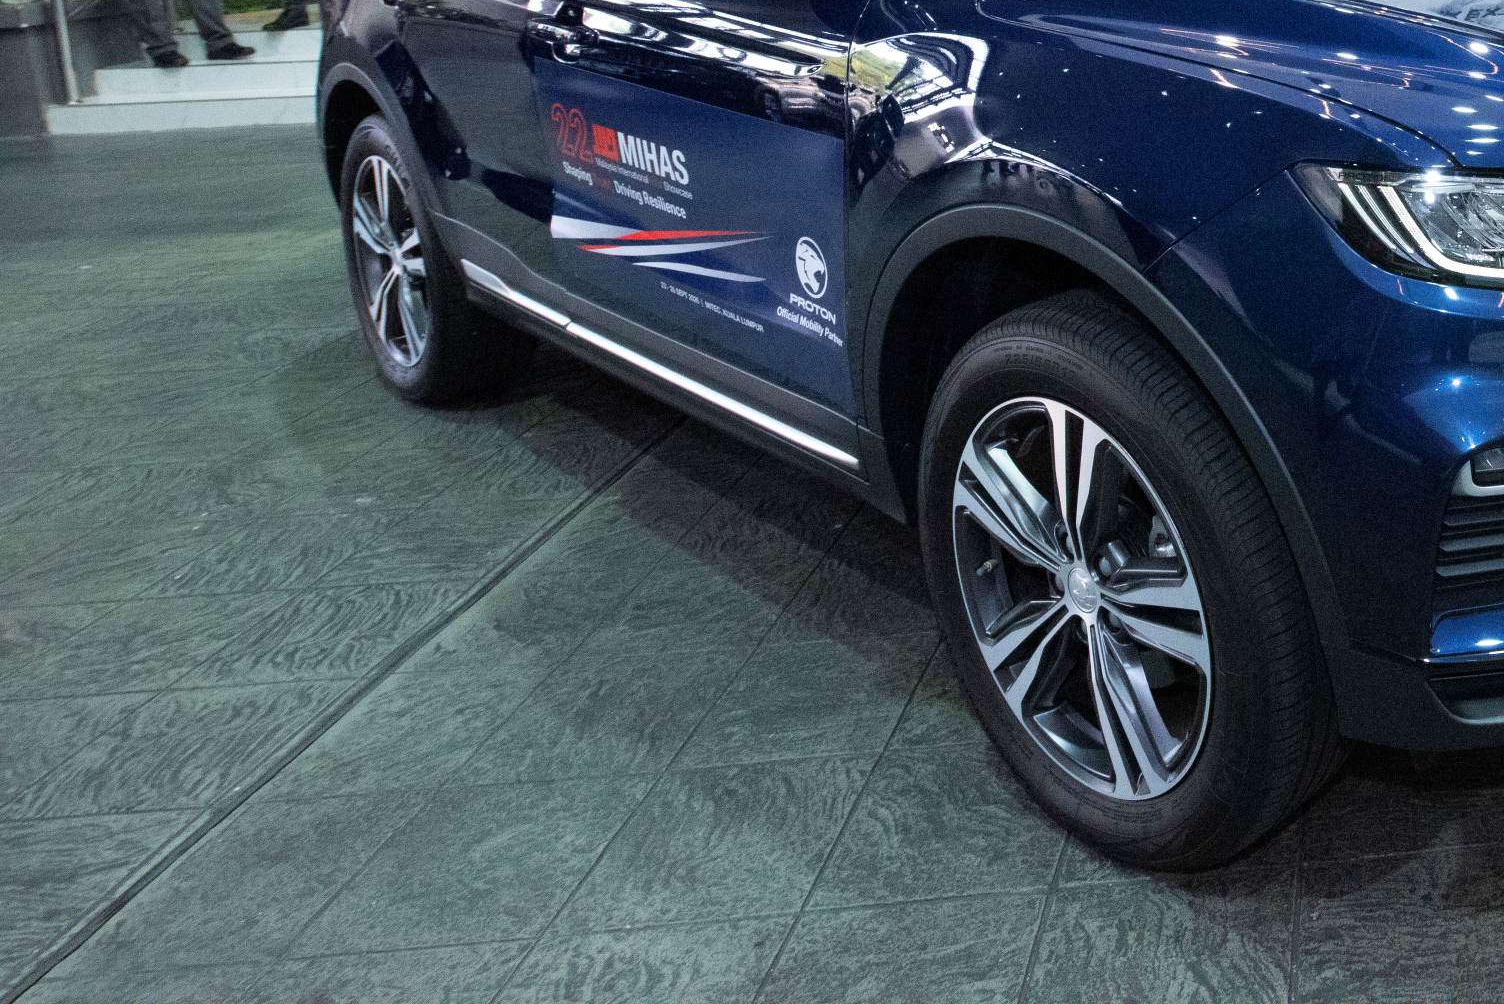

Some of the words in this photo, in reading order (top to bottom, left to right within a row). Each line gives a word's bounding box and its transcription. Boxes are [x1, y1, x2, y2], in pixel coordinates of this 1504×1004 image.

[551, 102, 595, 164] 22
[617, 131, 689, 185] MIHAS
[562, 161, 593, 186] Shaping
[613, 180, 644, 206] Driving
[643, 190, 687, 219] Resilience
[776, 306, 800, 324] Official
[800, 317, 825, 336] Mobility
[824, 327, 843, 347] Partner
[789, 293, 836, 325] PROTON
